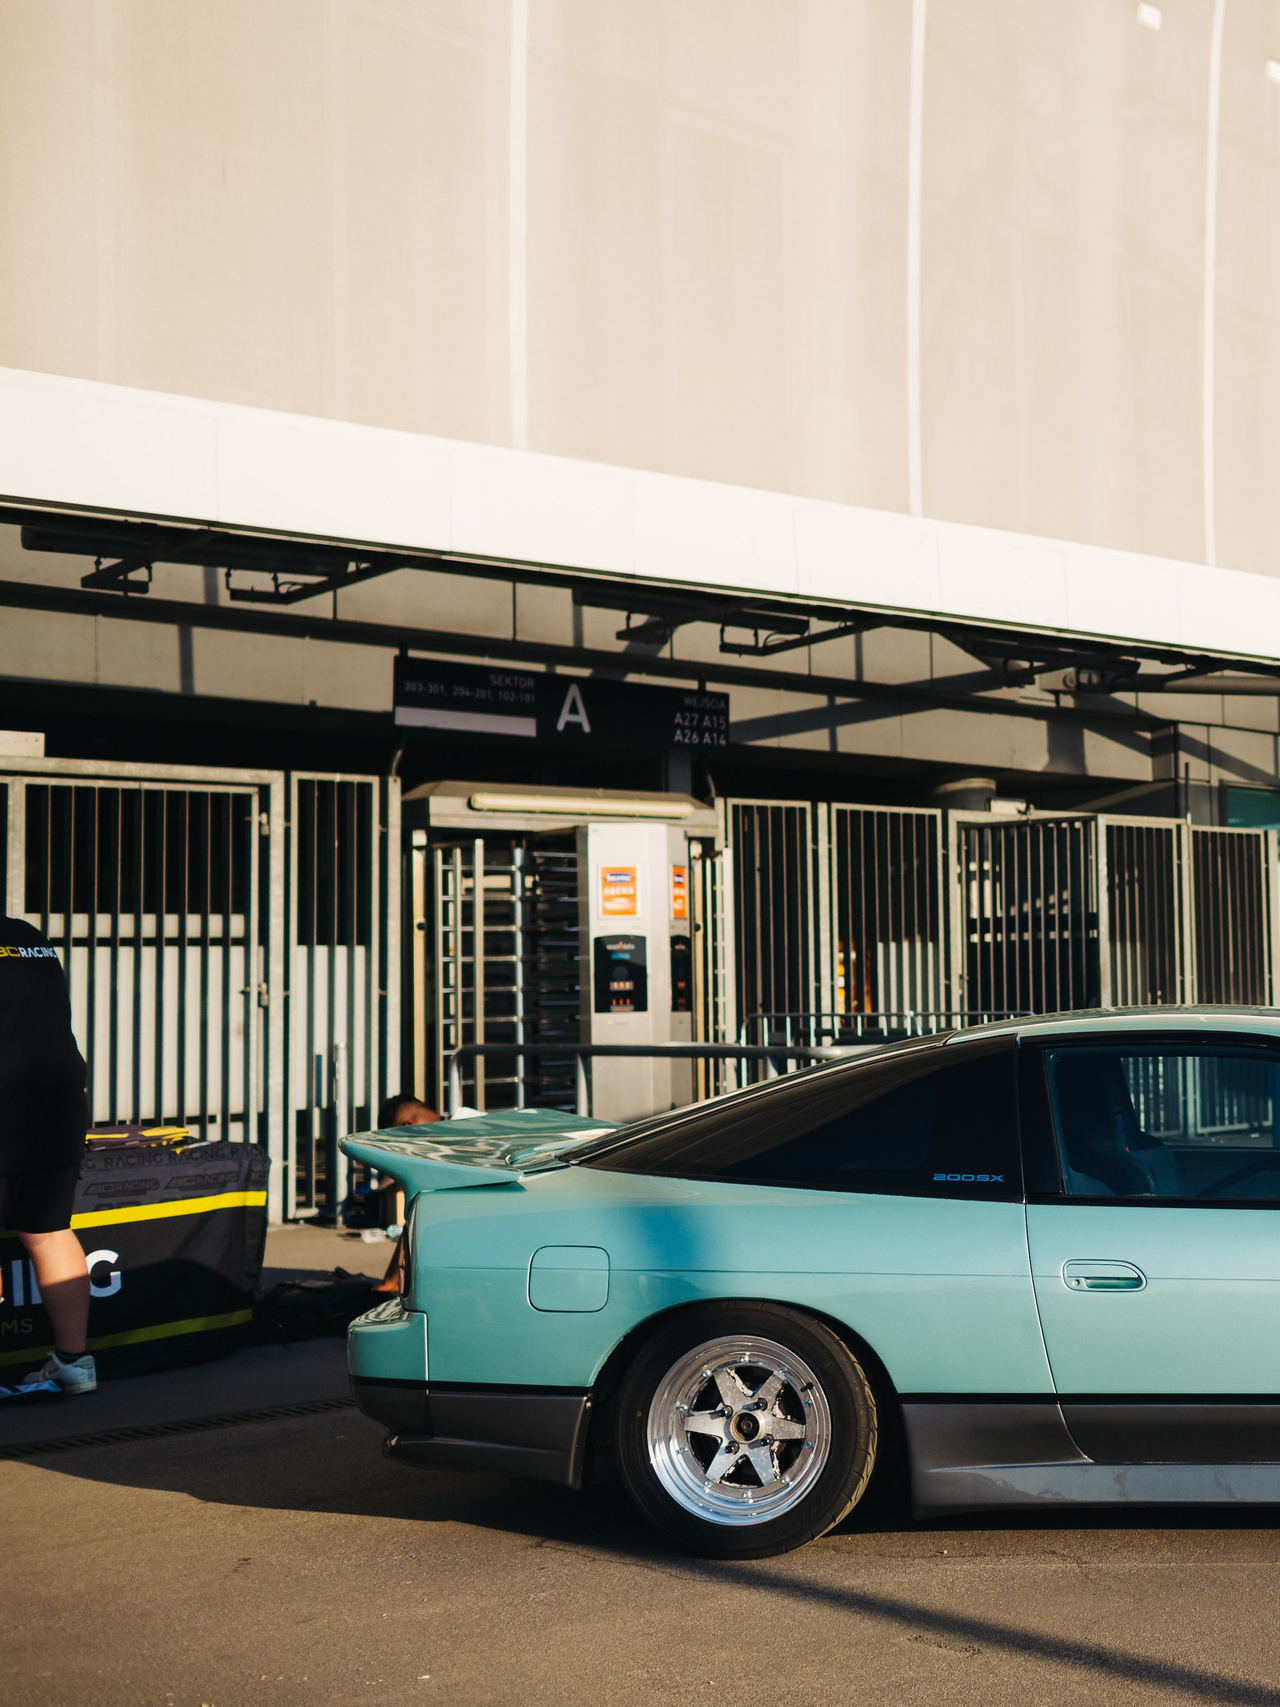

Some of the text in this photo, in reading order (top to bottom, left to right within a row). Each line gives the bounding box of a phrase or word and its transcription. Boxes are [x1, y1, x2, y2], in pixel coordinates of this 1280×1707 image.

[490, 672, 535, 689] SEKTOR
[403, 679, 535, 704] 303-301, 204-201, 102-101
[556, 683, 591, 733] A
[674, 711, 727, 730] A27 A15
[674, 728, 727, 746] A26 A14
[104, 1153, 164, 1169] RACING
[933, 1173, 1004, 1182] 200SX
